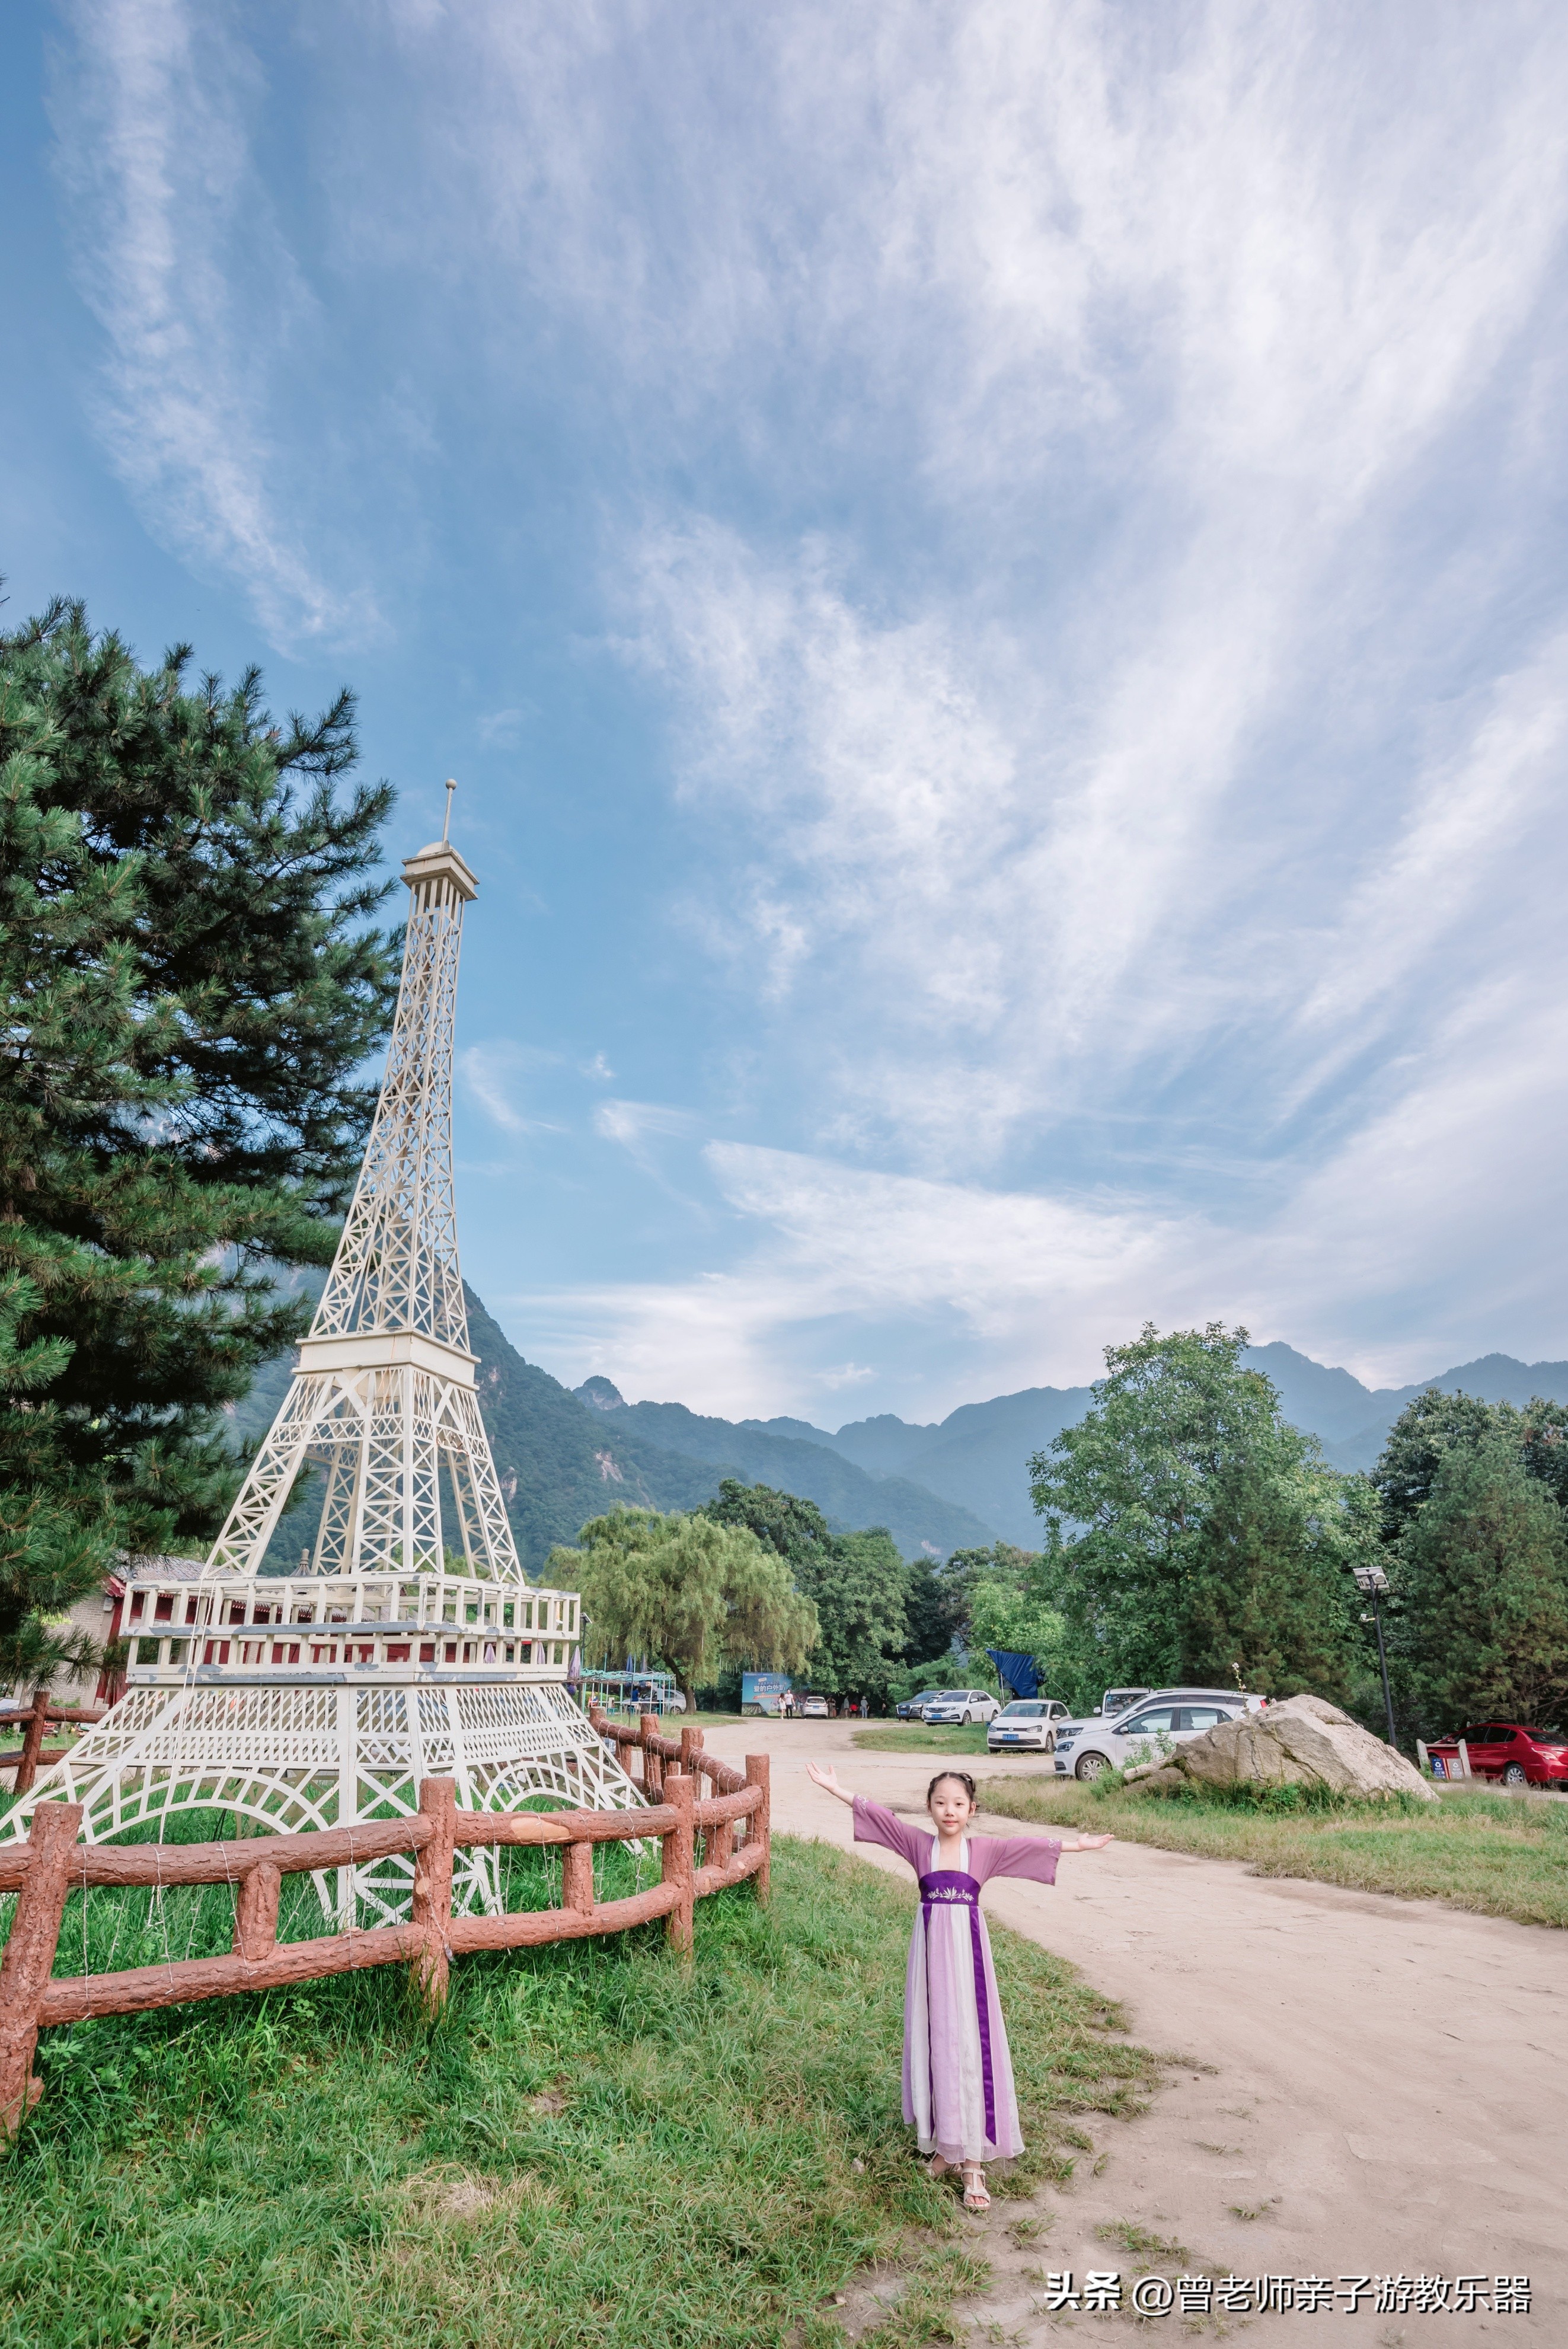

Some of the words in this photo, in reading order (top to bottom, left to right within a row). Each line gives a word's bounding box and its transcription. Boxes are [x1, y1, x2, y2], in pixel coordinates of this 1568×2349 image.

[753, 1684, 786, 1693] 爱的户外趴
